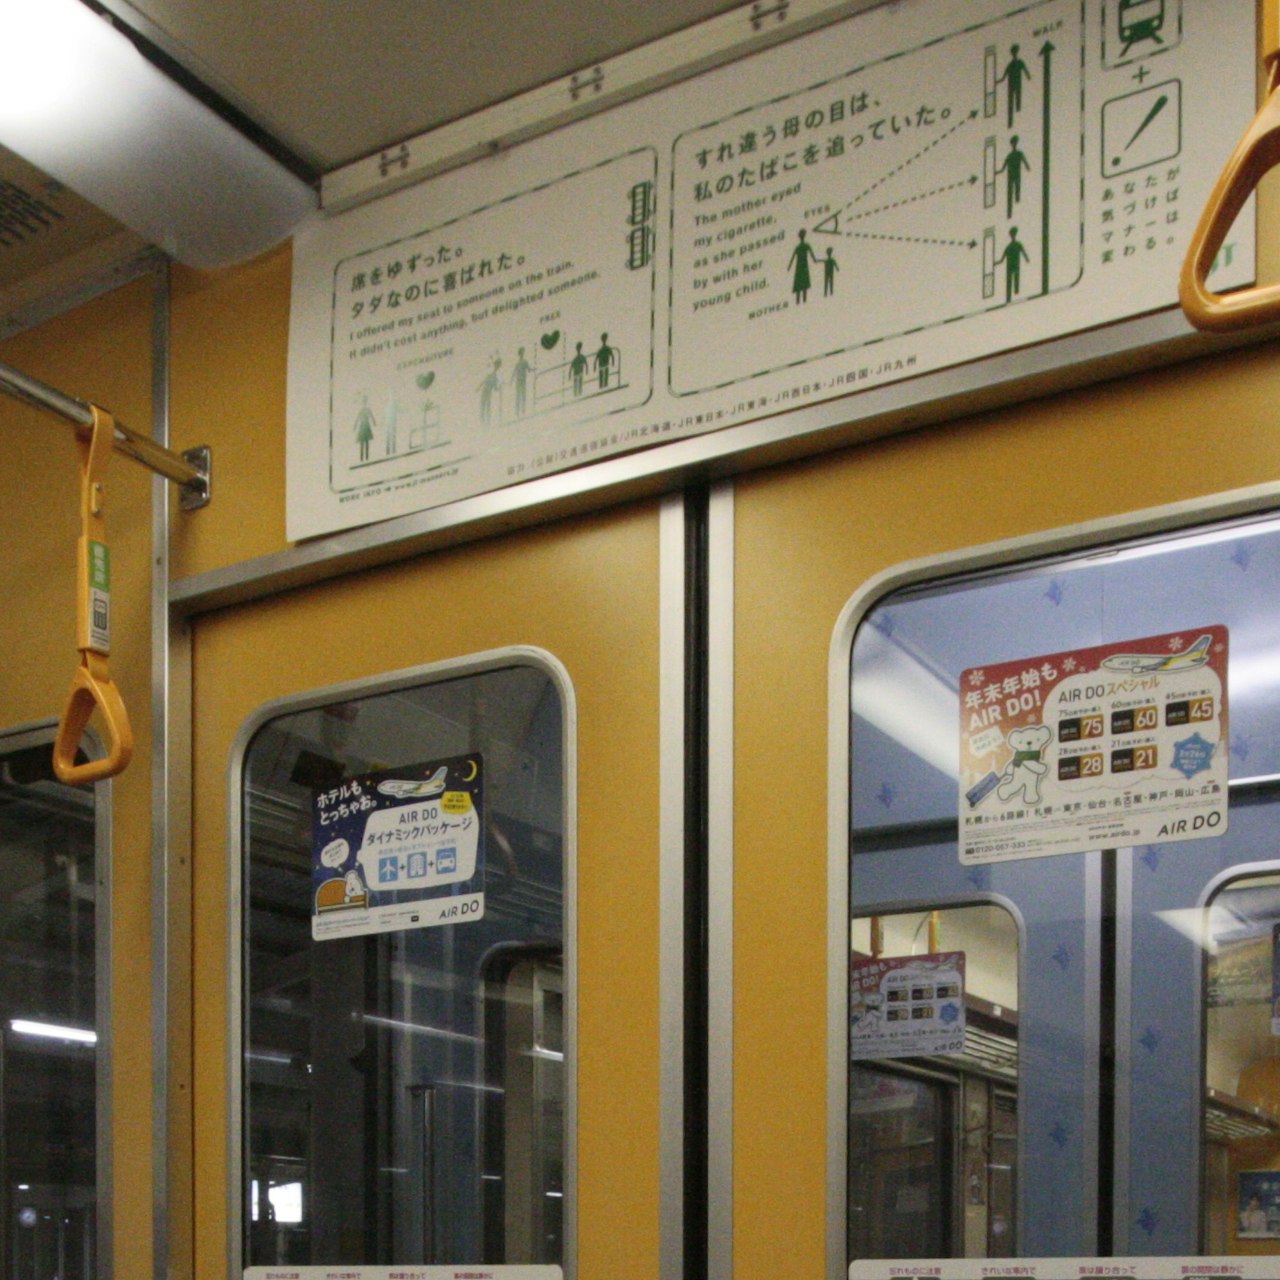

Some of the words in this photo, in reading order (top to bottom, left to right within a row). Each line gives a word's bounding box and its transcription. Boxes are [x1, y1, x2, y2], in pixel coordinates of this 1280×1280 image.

[1032, 19, 1064, 38] WALK
[695, 91, 880, 170] すれ違う母の目は、
[693, 104, 951, 202] 私のたばこを追っていた。
[694, 212, 718, 227] The
[722, 197, 766, 219] mother
[771, 182, 802, 203] eyed
[804, 204, 831, 219] EYES
[693, 256, 709, 269] as
[713, 248, 735, 264] she
[739, 230, 786, 257] passed
[694, 234, 713, 248] my
[351, 244, 463, 293] 席をゆずった。
[693, 277, 708, 291] by
[712, 265, 738, 284] with
[743, 259, 763, 274] her
[350, 251, 526, 319] タダなのに喜ばれた。
[692, 291, 731, 313] young
[735, 277, 770, 298] child.
[356, 321, 395, 341] offered
[398, 316, 414, 328] my
[417, 307, 441, 322] seat
[443, 303, 453, 315] to
[456, 285, 505, 312] someone
[508, 279, 523, 291] on
[525, 271, 544, 286] the
[546, 261, 575, 278] train.
[360, 340, 392, 359] didn't
[394, 333, 418, 347] cost
[421, 318, 469, 341] anything,
[471, 309, 489, 325] but
[491, 290, 544, 317] delighted
[547, 270, 602, 297] someone.
[748, 301, 789, 320] MOTHER
[965, 663, 1057, 708] 年末年始も
[1058, 689, 1081, 704] AIR
[970, 704, 1002, 731] AIR
[1006, 689, 1041, 717] DO!
[1136, 710, 1156, 728] 60
[1190, 700, 1212, 718] 45
[1082, 717, 1102, 735] 75
[1082, 756, 1101, 774] 28
[1136, 749, 1154, 767] 21
[317, 780, 362, 808] ホテルも
[320, 794, 377, 826] とっちゃお。
[399, 809, 418, 824] AIR
[422, 807, 437, 820] DO
[1158, 820, 1186, 837] AIR
[1192, 811, 1220, 830] DO
[439, 907, 458, 919] AIR
[461, 899, 479, 914] DO
